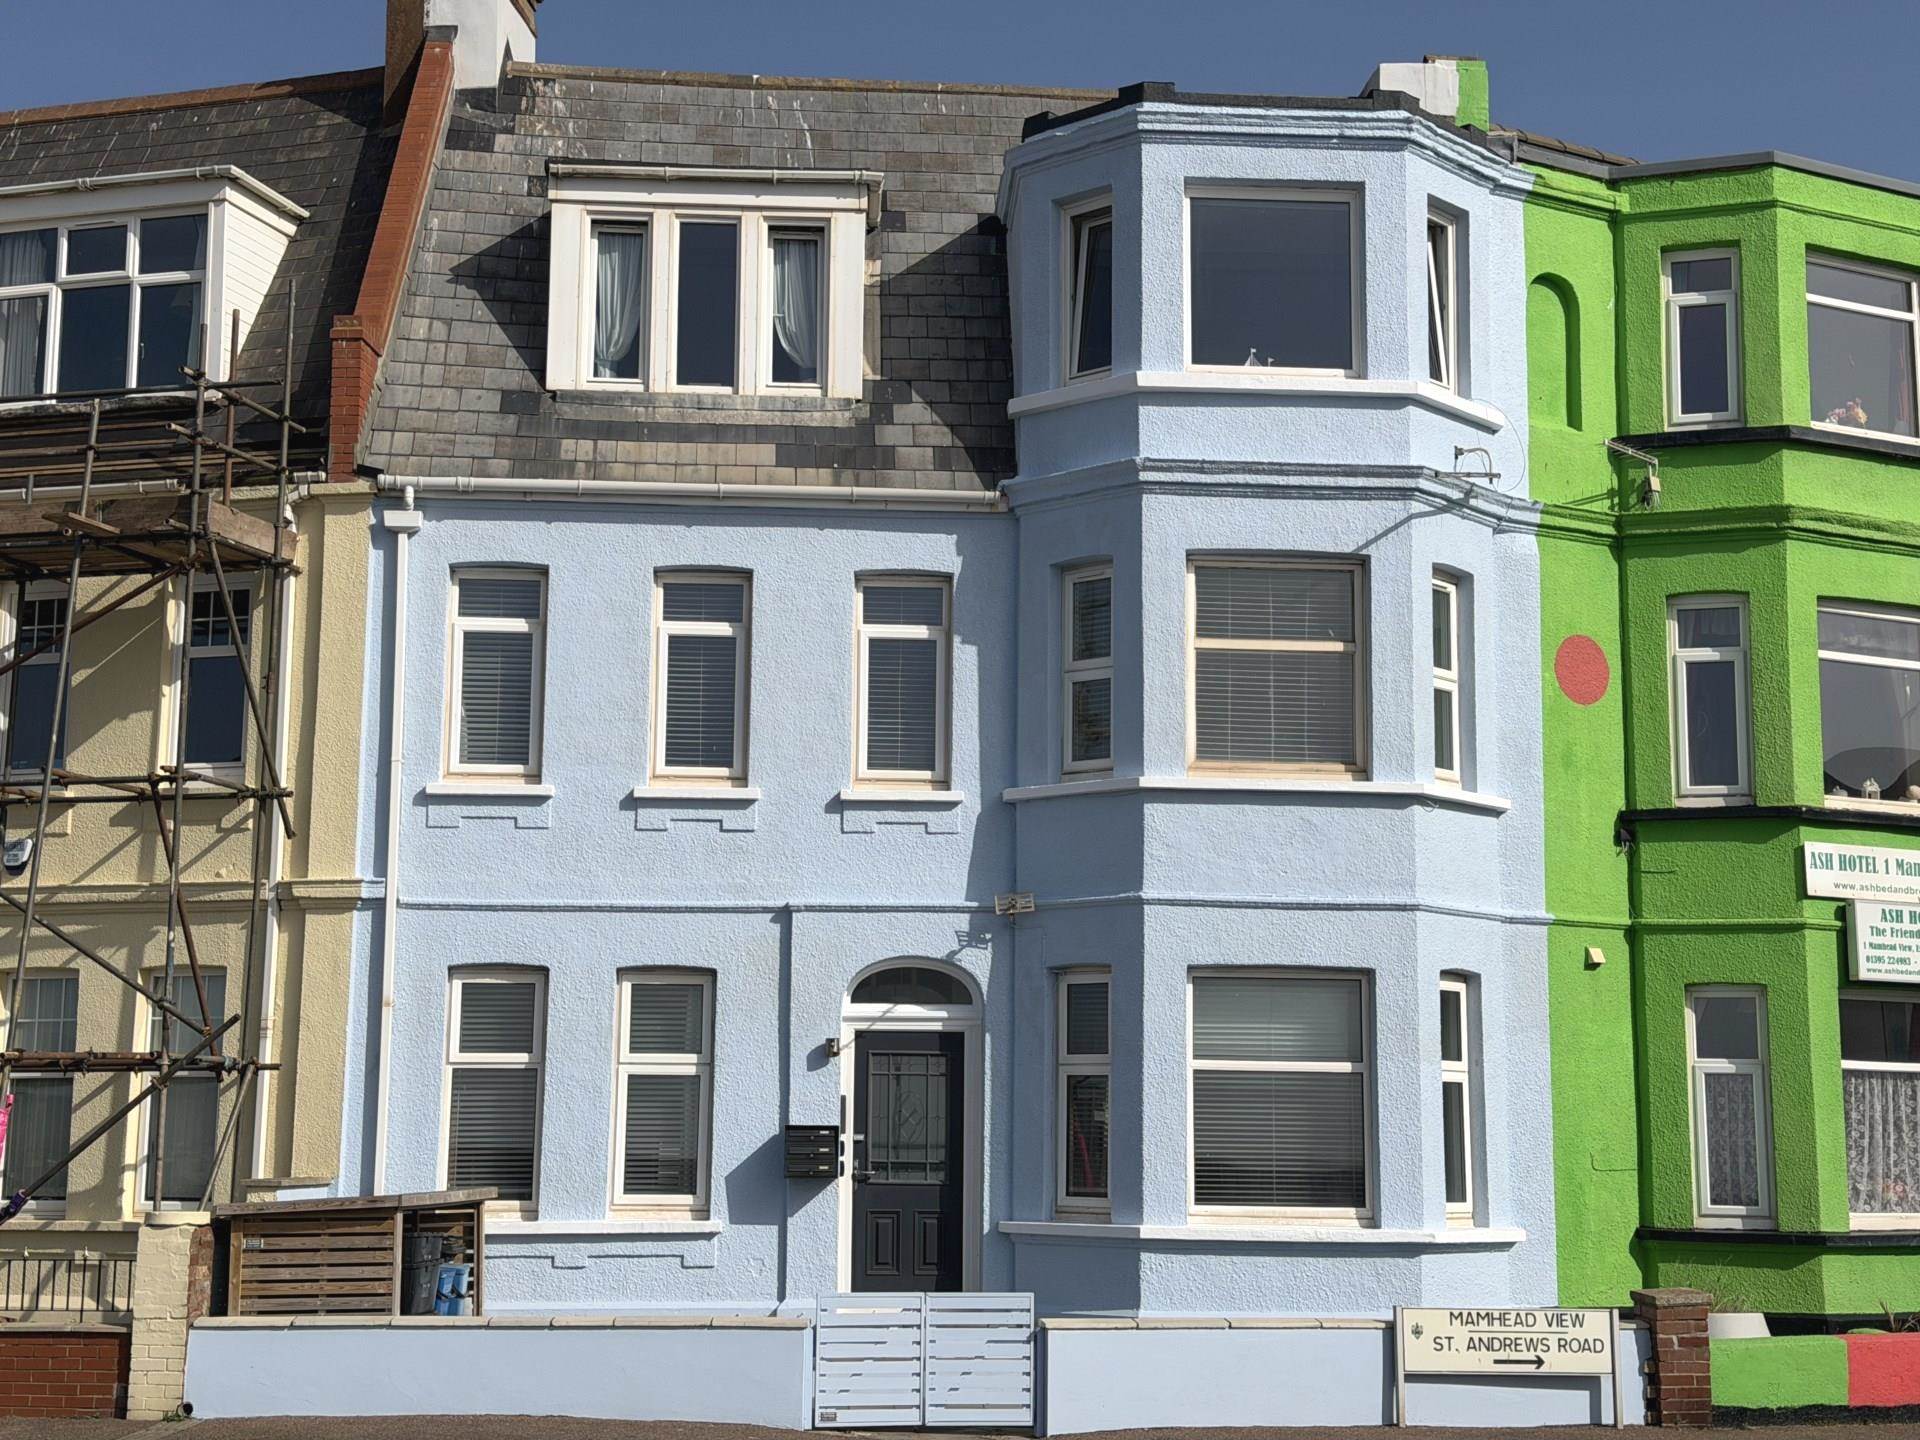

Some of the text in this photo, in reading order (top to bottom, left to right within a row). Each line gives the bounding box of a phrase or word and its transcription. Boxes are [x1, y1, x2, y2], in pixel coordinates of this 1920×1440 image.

[1810, 852, 1834, 870] ASH
[1838, 853, 1879, 874] HOTEL
[1884, 857, 1890, 875] 1
[1880, 908, 1904, 923] ASH
[1869, 925, 1888, 937] The
[1450, 1311, 1586, 1329] MAMHEAD VIEW
[1433, 1336, 1605, 1354] ST. ANDREWS ROAD
